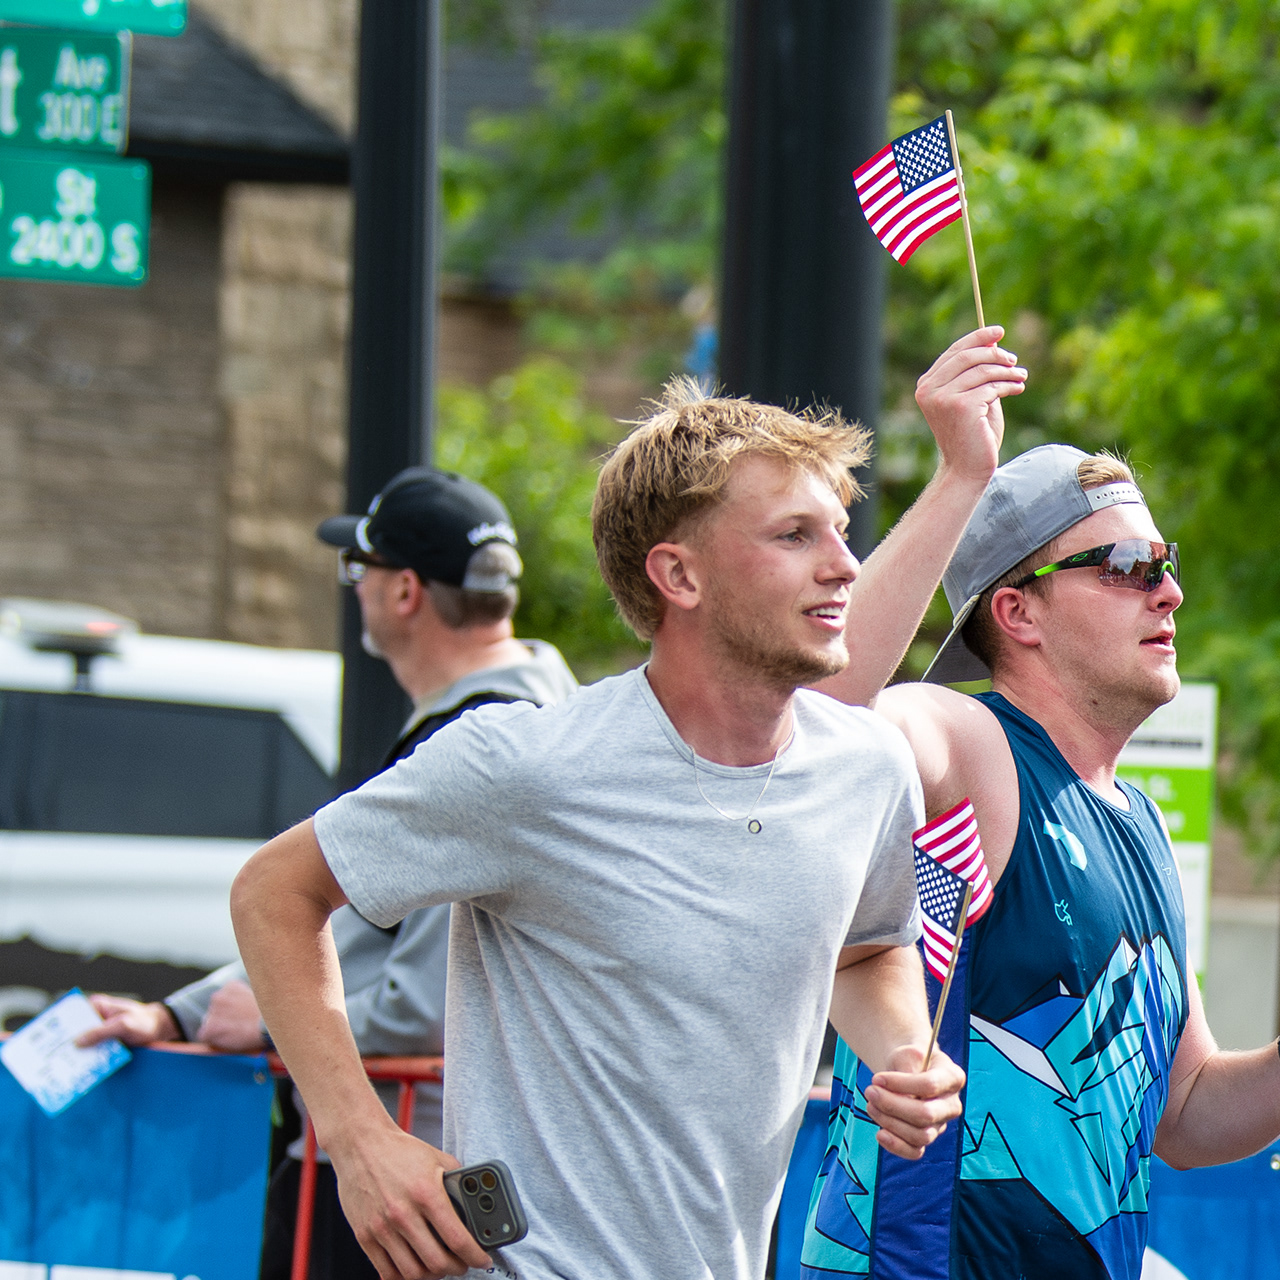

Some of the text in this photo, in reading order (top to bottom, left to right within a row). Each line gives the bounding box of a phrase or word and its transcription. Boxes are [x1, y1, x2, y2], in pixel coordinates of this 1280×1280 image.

[54, 44, 110, 91] Ave
[55, 167, 97, 217] St
[10, 215, 142, 274] 2400 S
